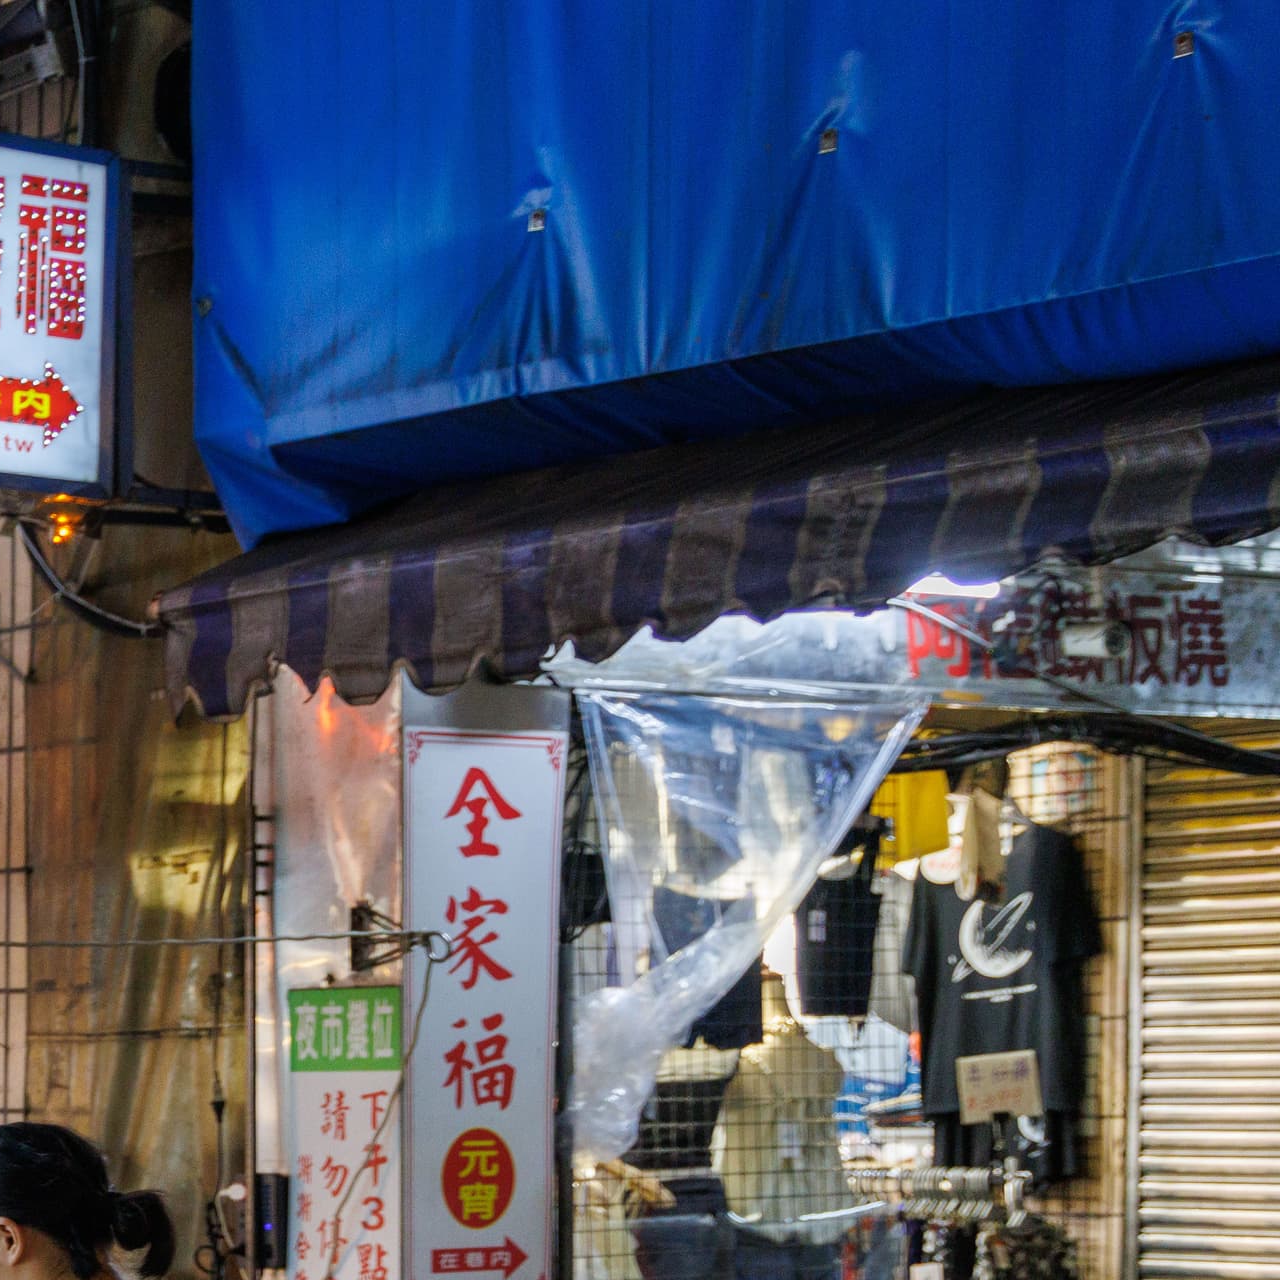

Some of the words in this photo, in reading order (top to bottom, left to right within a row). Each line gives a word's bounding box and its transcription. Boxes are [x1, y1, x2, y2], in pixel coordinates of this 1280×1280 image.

[441, 767, 524, 1111] 全家福
[458, 1140, 500, 1220] 元宵
